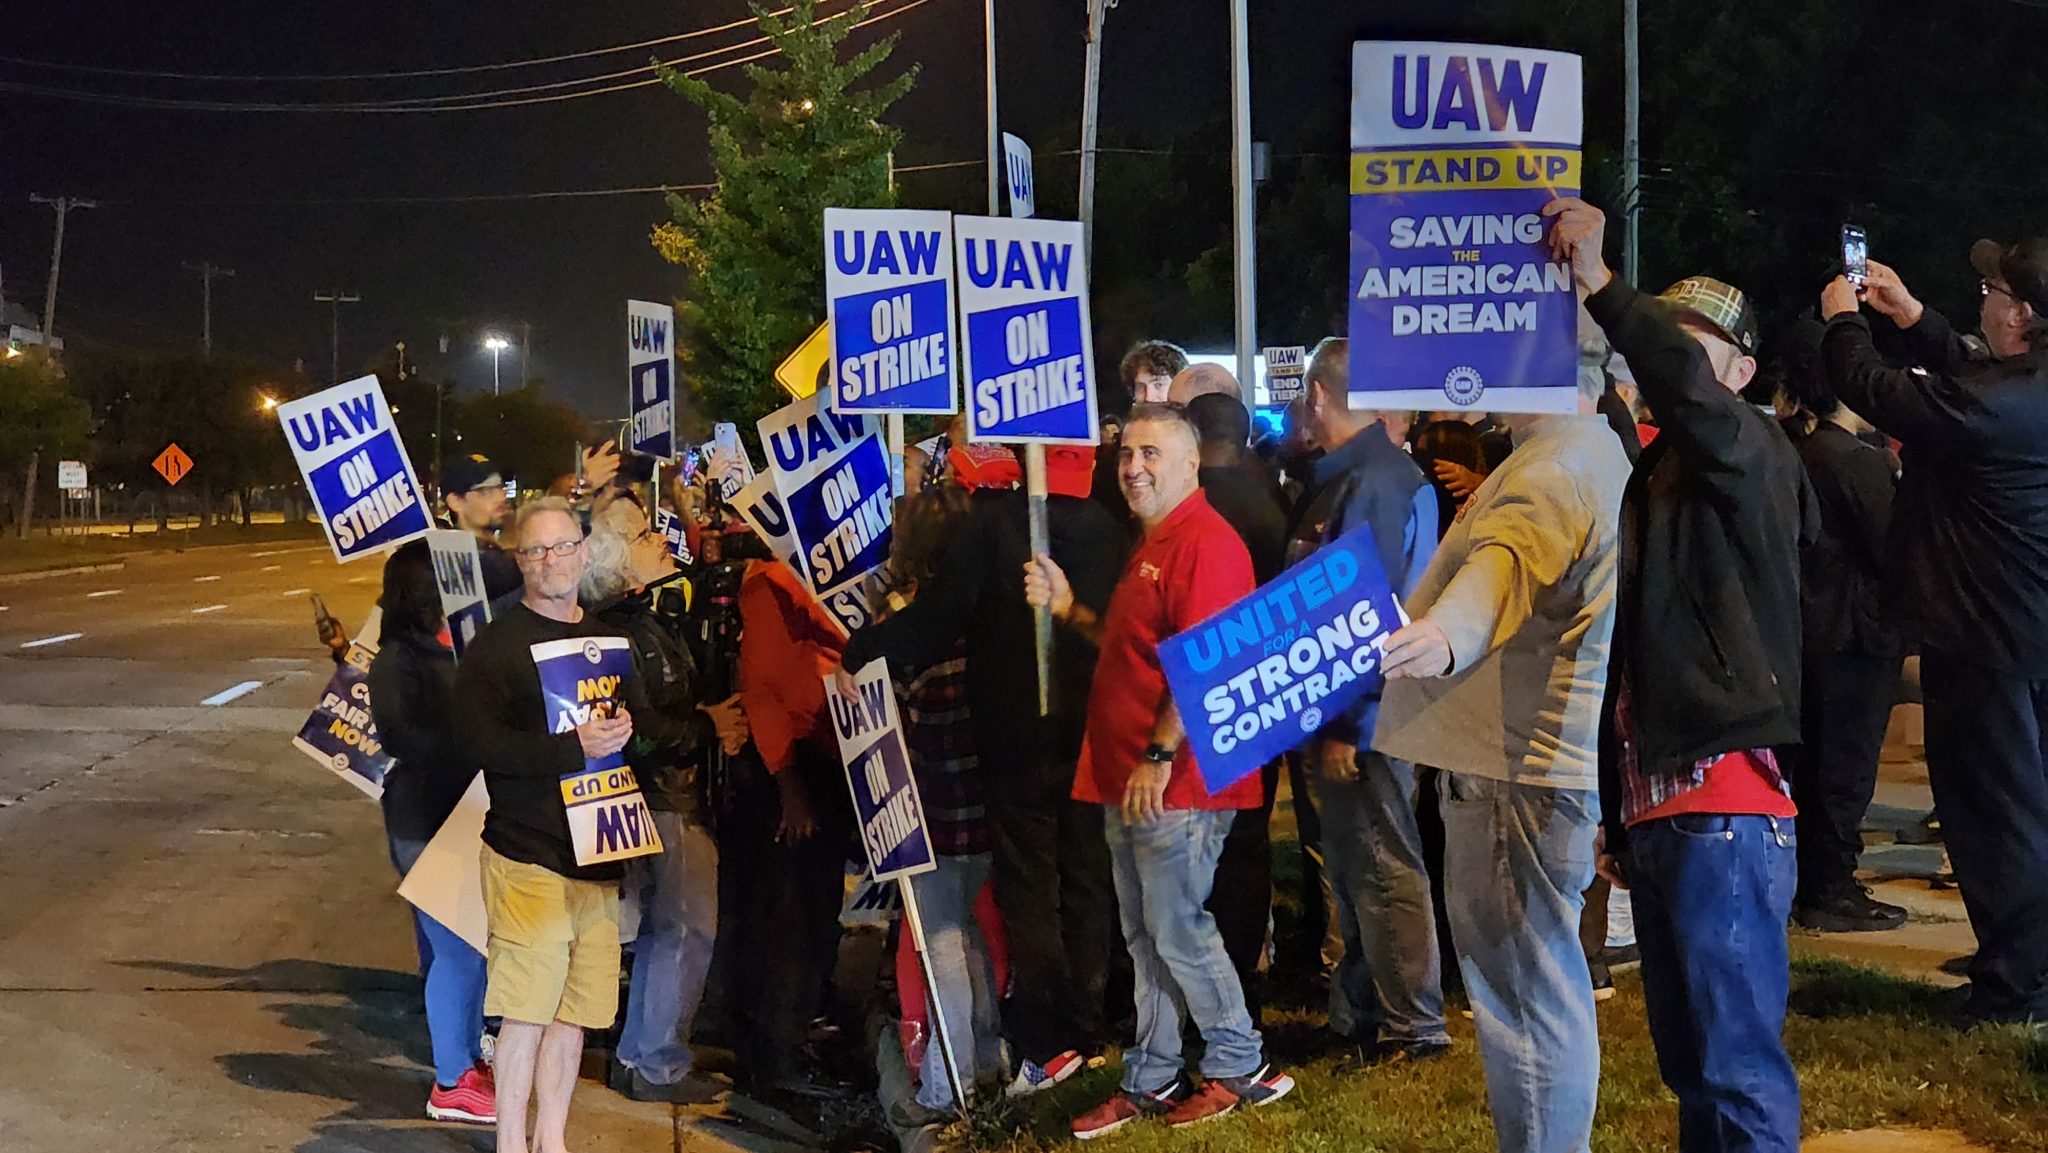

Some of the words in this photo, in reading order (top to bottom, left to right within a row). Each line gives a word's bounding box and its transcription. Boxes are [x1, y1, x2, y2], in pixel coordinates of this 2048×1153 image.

[1392, 54, 1548, 132] UAW
[1009, 152, 1032, 208] UA
[1366, 156, 1501, 186] STAND
[1516, 155, 1568, 182] UP
[833, 230, 941, 276] UAW
[1389, 213, 1544, 249] SAVING
[1452, 250, 1480, 262] THE
[965, 238, 1072, 292] UAW
[1357, 262, 1571, 299] AMERICAN
[631, 314, 667, 354] UAW
[871, 293, 913, 344] ON
[1005, 309, 1050, 366] ON
[1392, 301, 1537, 336] DREAM
[841, 332, 946, 402] STRIKE
[1270, 350, 1298, 364] UAW
[976, 354, 1085, 429] STRIKE
[1273, 378, 1300, 389] END
[288, 392, 379, 452] UAW
[634, 400, 671, 445] STRIKE
[769, 406, 865, 472] UAW
[338, 449, 379, 499] ON
[821, 461, 861, 521] ON
[332, 470, 416, 550] STRIKE
[433, 550, 477, 596] UAW
[1182, 549, 1359, 673] UNITED
[1203, 599, 1380, 725] STRONG
[1263, 628, 1296, 657] FOR
[1300, 619, 1311, 636] A
[322, 692, 370, 730] FAIR
[832, 678, 888, 740] UAW
[328, 719, 382, 756] NOW
[572, 777, 601, 798] UP
[864, 748, 890, 806] ON
[866, 784, 919, 868] STRIKE
